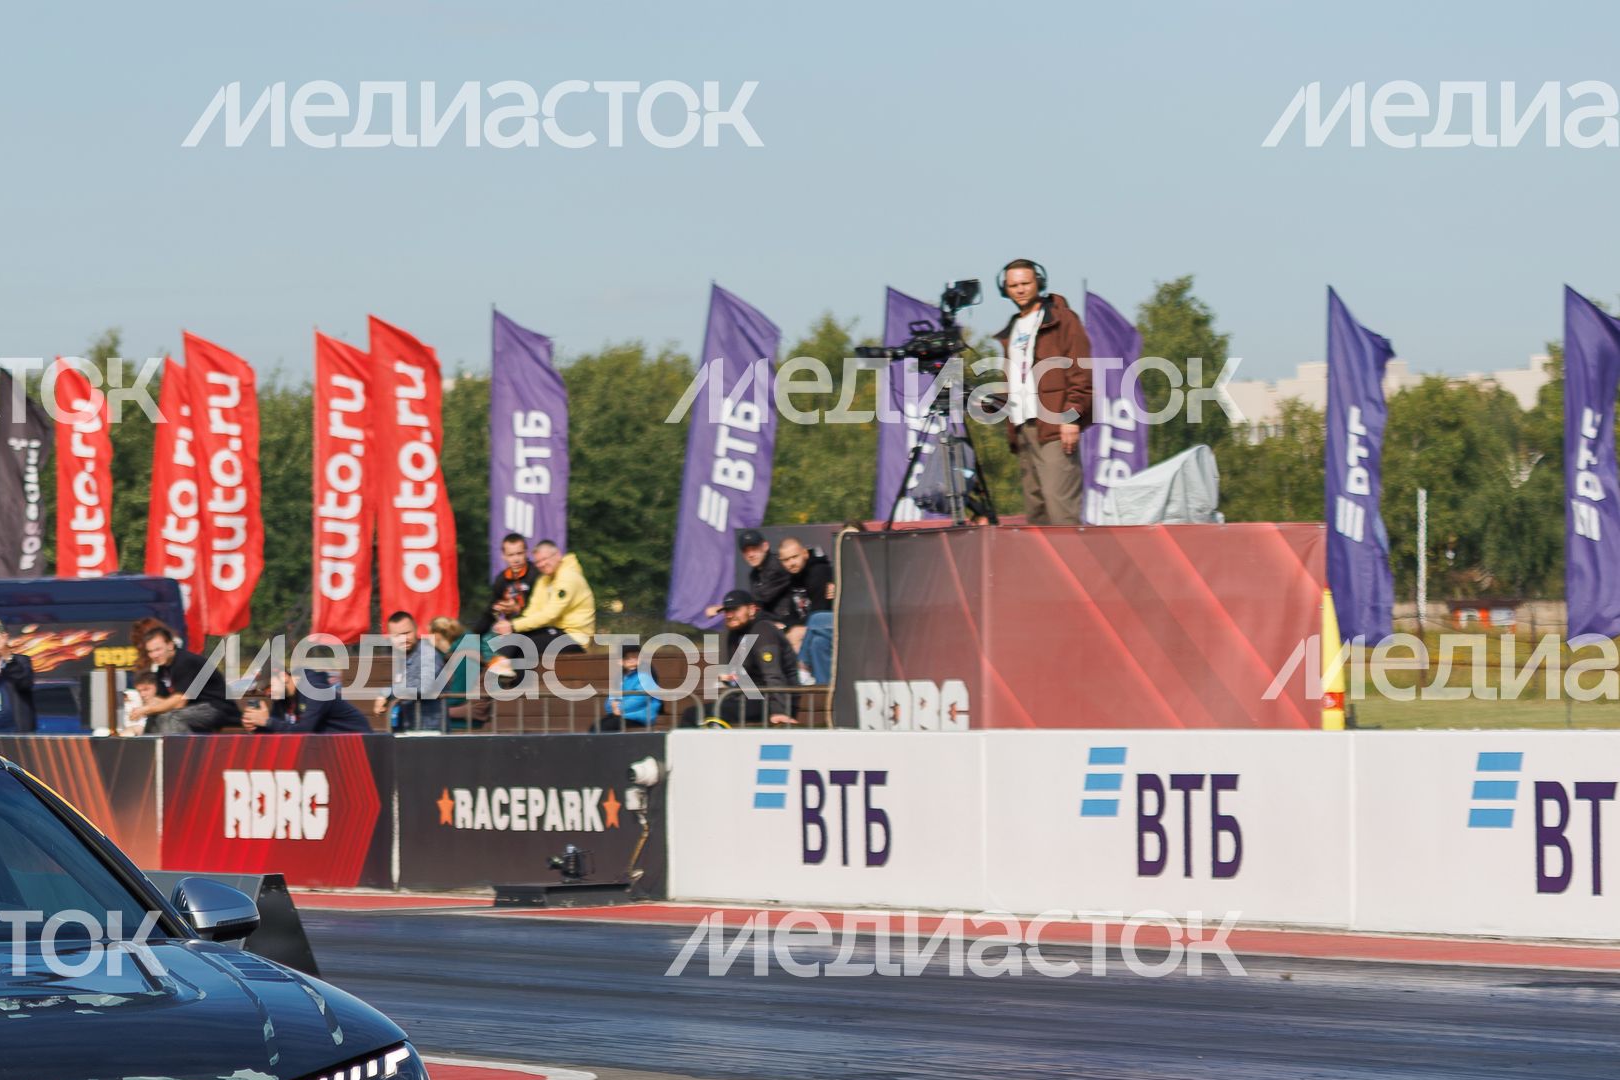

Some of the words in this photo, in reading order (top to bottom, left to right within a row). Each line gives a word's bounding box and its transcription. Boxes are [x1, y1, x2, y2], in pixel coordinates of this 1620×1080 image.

[70, 398, 106, 578] uto.ru
[207, 371, 248, 592] auto.ru
[318, 373, 366, 601] auto.ru
[393, 359, 442, 593] auto.ru
[513, 409, 552, 495] ВТБ
[711, 397, 761, 492] ВТБ
[223, 769, 330, 841] RDRC
[454, 787, 605, 833] RACEPARK
[800, 768, 892, 868] ВТБ
[1136, 772, 1244, 880] ВТБ
